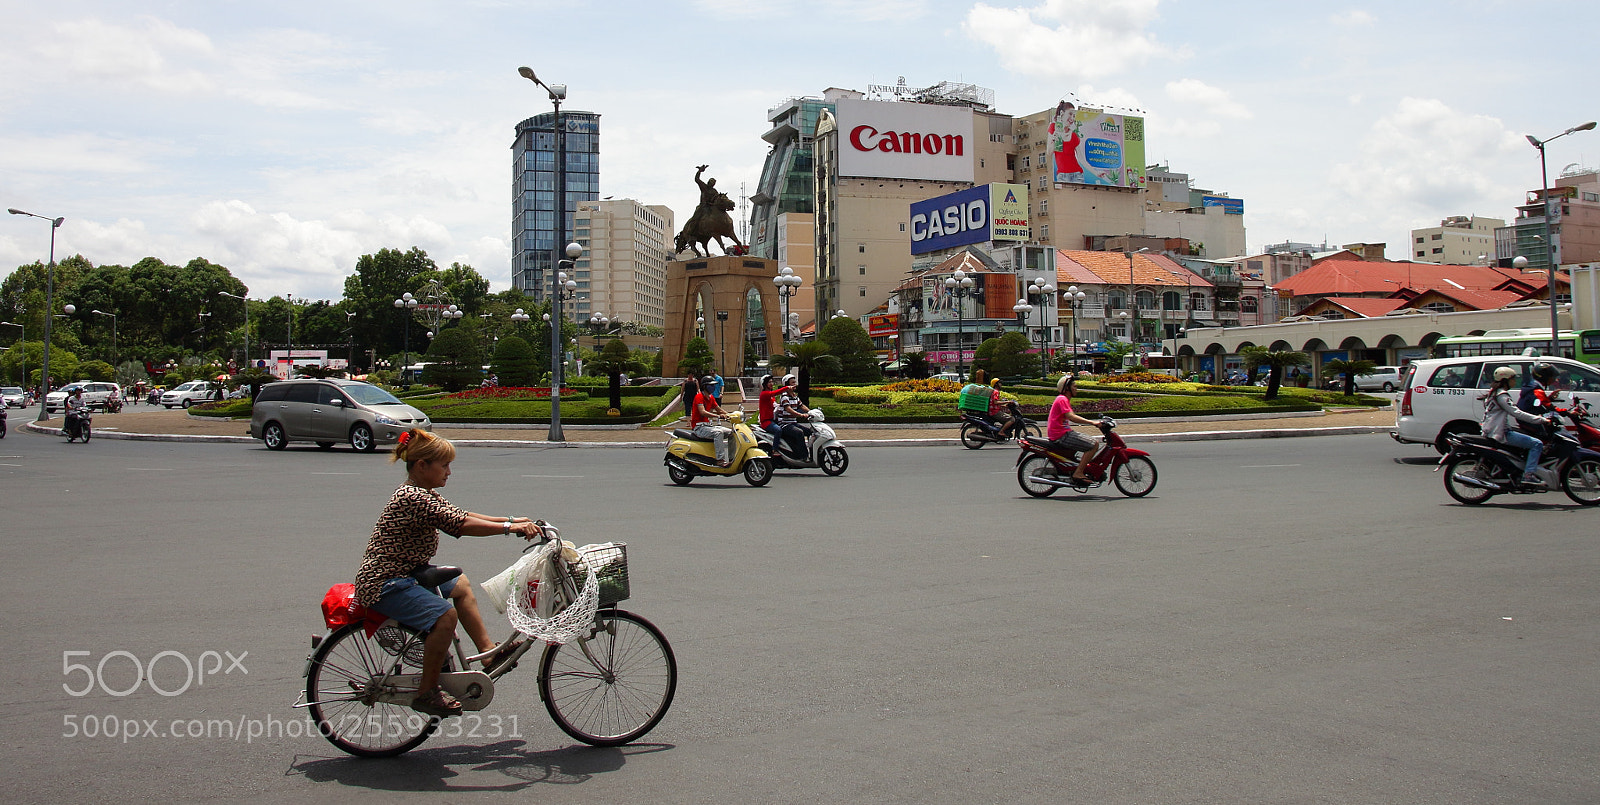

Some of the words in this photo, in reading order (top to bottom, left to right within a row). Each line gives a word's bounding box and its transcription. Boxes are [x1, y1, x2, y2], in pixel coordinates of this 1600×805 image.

[850, 125, 963, 156] Canon
[911, 199, 986, 242] CASIO
[1010, 218, 1027, 226] HOÀNG
